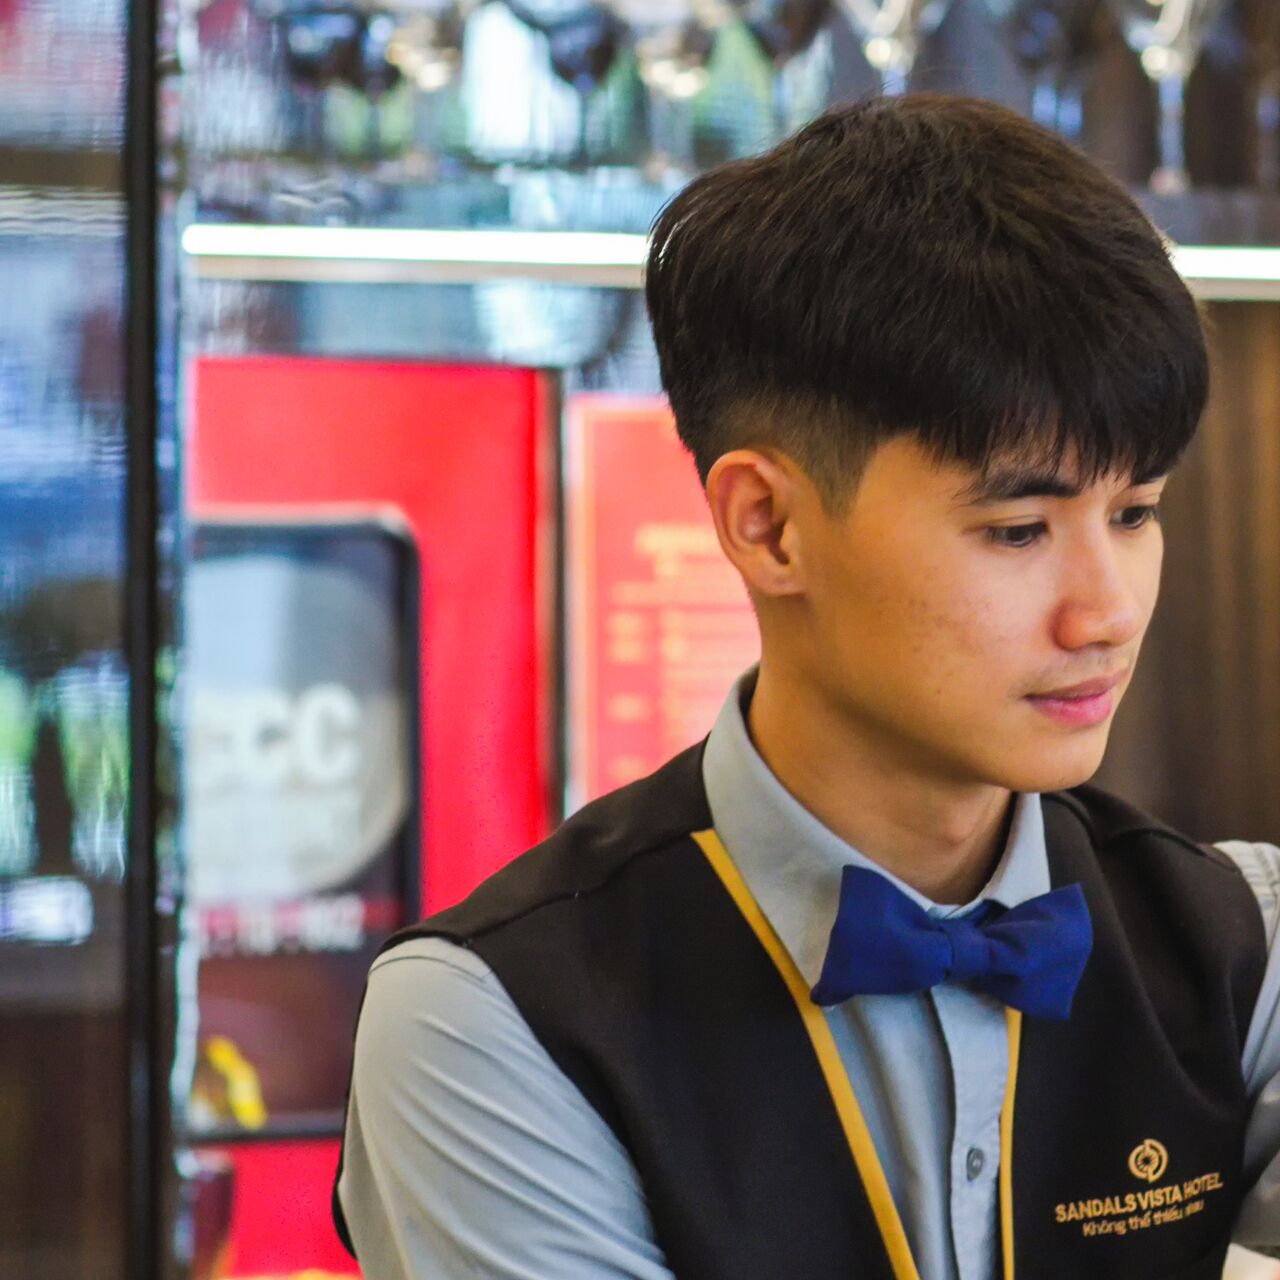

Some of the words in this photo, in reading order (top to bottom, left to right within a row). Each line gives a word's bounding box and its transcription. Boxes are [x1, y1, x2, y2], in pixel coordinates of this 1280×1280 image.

[1055, 1192, 1137, 1223] SANDALS
[1136, 1183, 1183, 1210] VISTA
[1183, 1172, 1224, 1198] HOTEL
